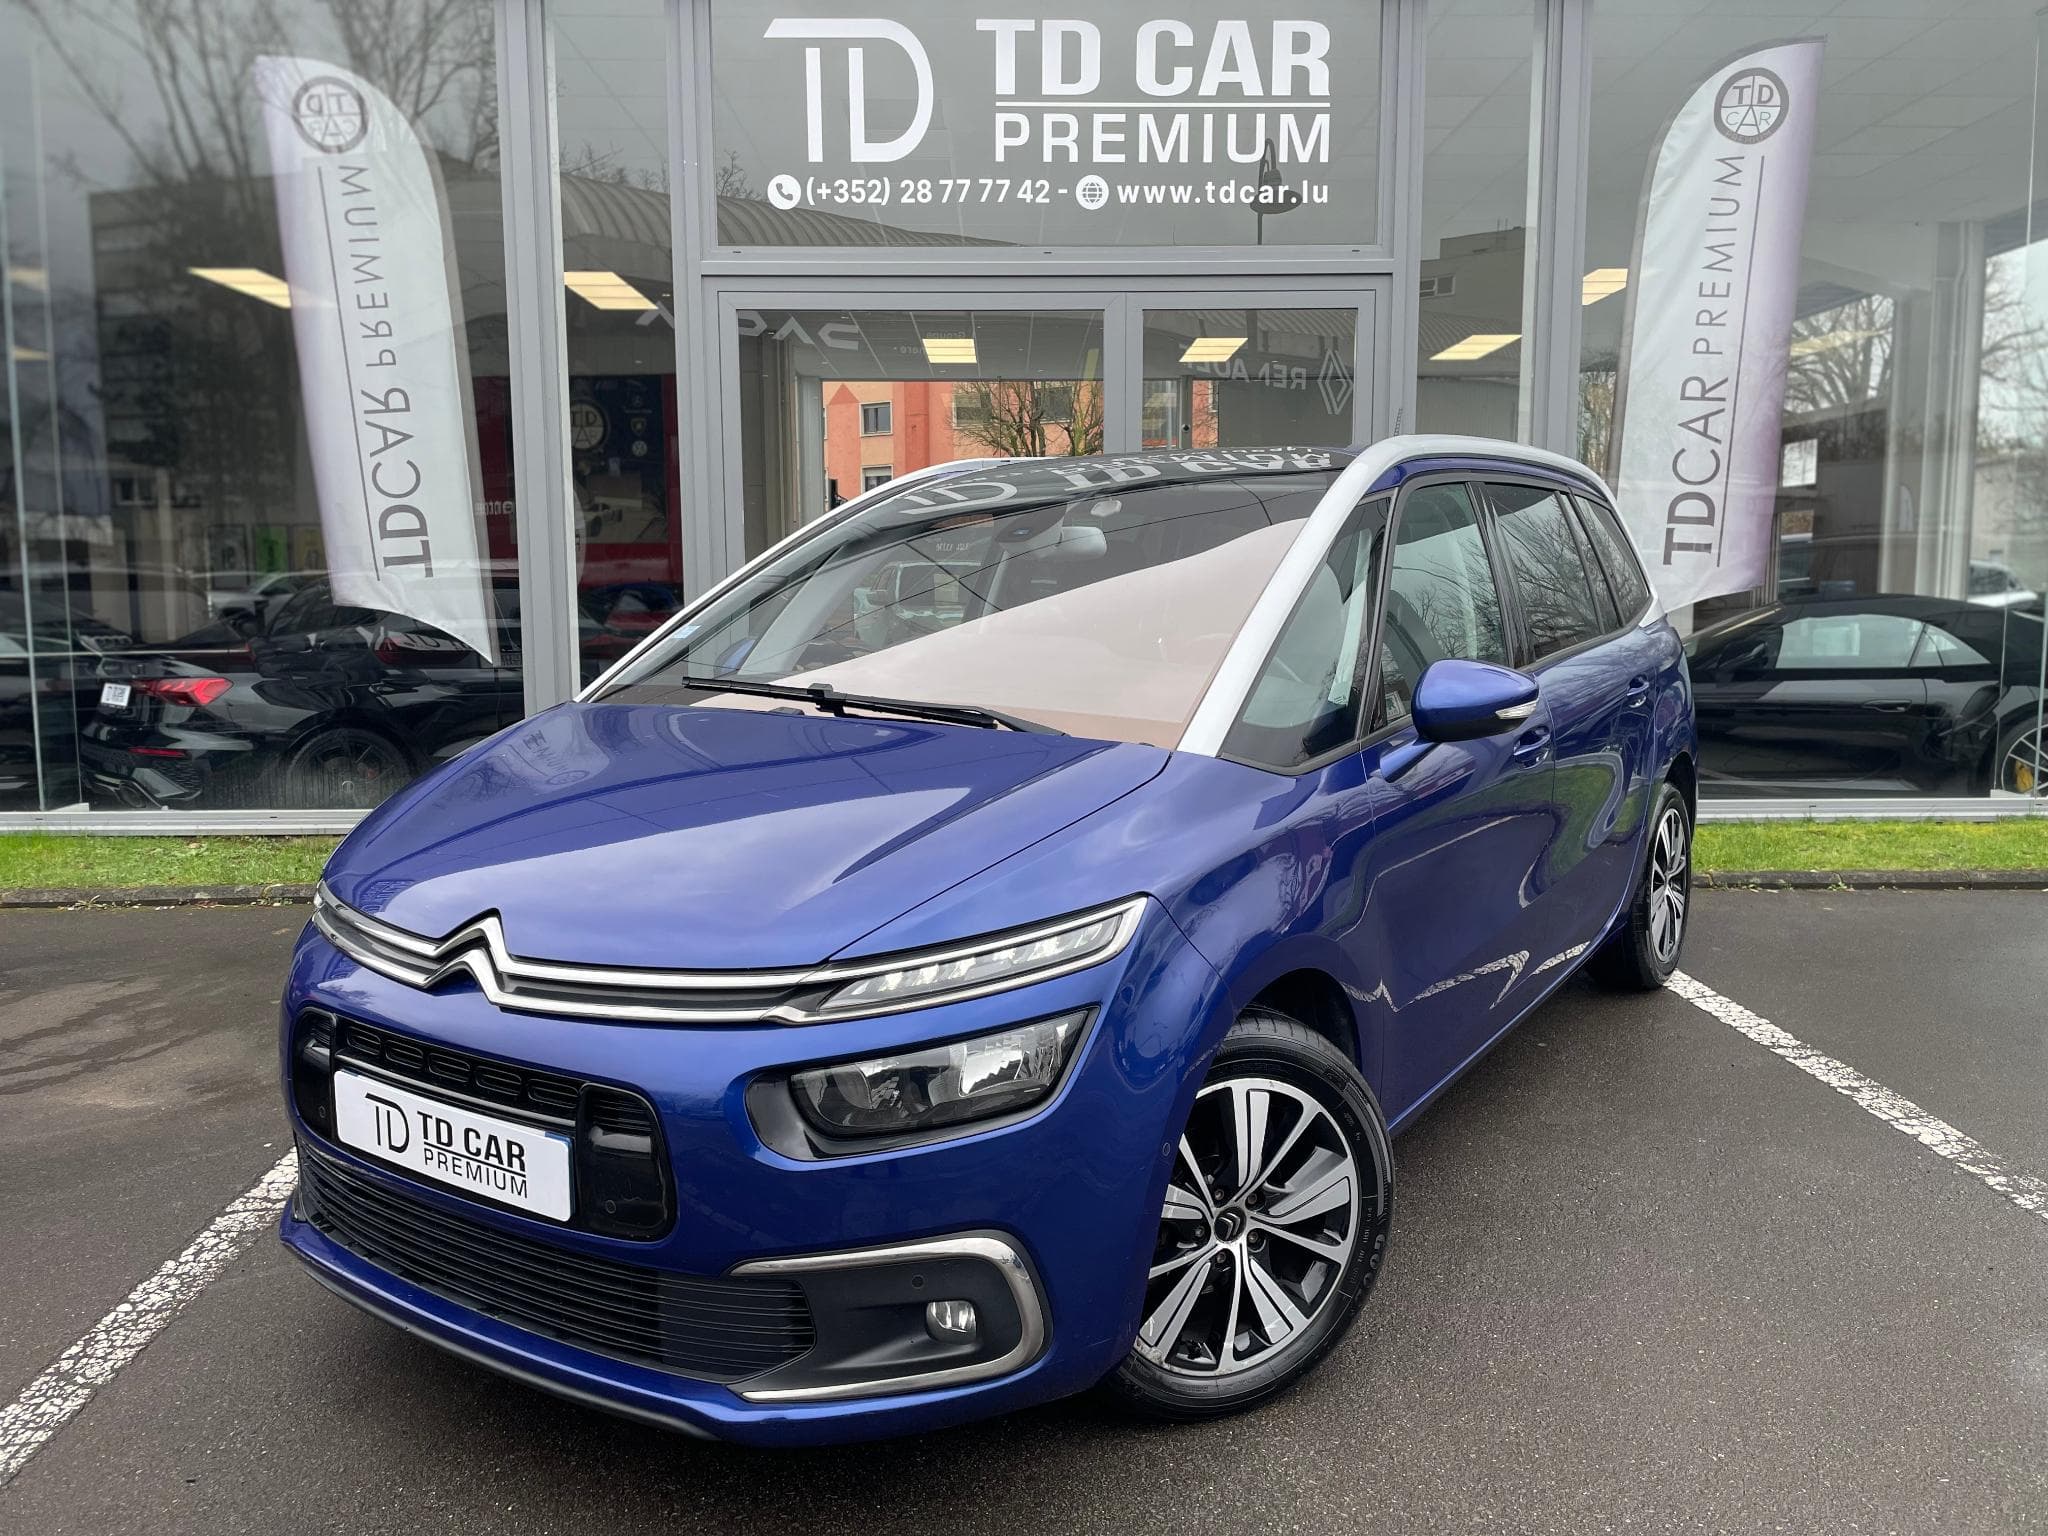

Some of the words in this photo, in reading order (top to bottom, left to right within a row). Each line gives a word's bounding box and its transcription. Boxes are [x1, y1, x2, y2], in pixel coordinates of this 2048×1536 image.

[975, 19, 1101, 96] TD
[1136, 19, 1330, 96] CAR
[1726, 106, 1771, 133] CAR
[1733, 84, 1774, 105] TD
[996, 113, 1330, 164] PREMIUM
[806, 177, 890, 205] (+352)
[900, 179, 933, 204] 28
[939, 179, 971, 204] 77
[978, 179, 1011, 204] 77
[1017, 179, 1050, 204] 42
[1117, 179, 1329, 204] www.tdcar.lu
[1692, 156, 1745, 355] PREMIUM
[1662, 375, 1729, 566] TDCAR
[417, 1110, 453, 1148] TD
[463, 1127, 526, 1173] CAR
[423, 1147, 528, 1199] PREMIUM
